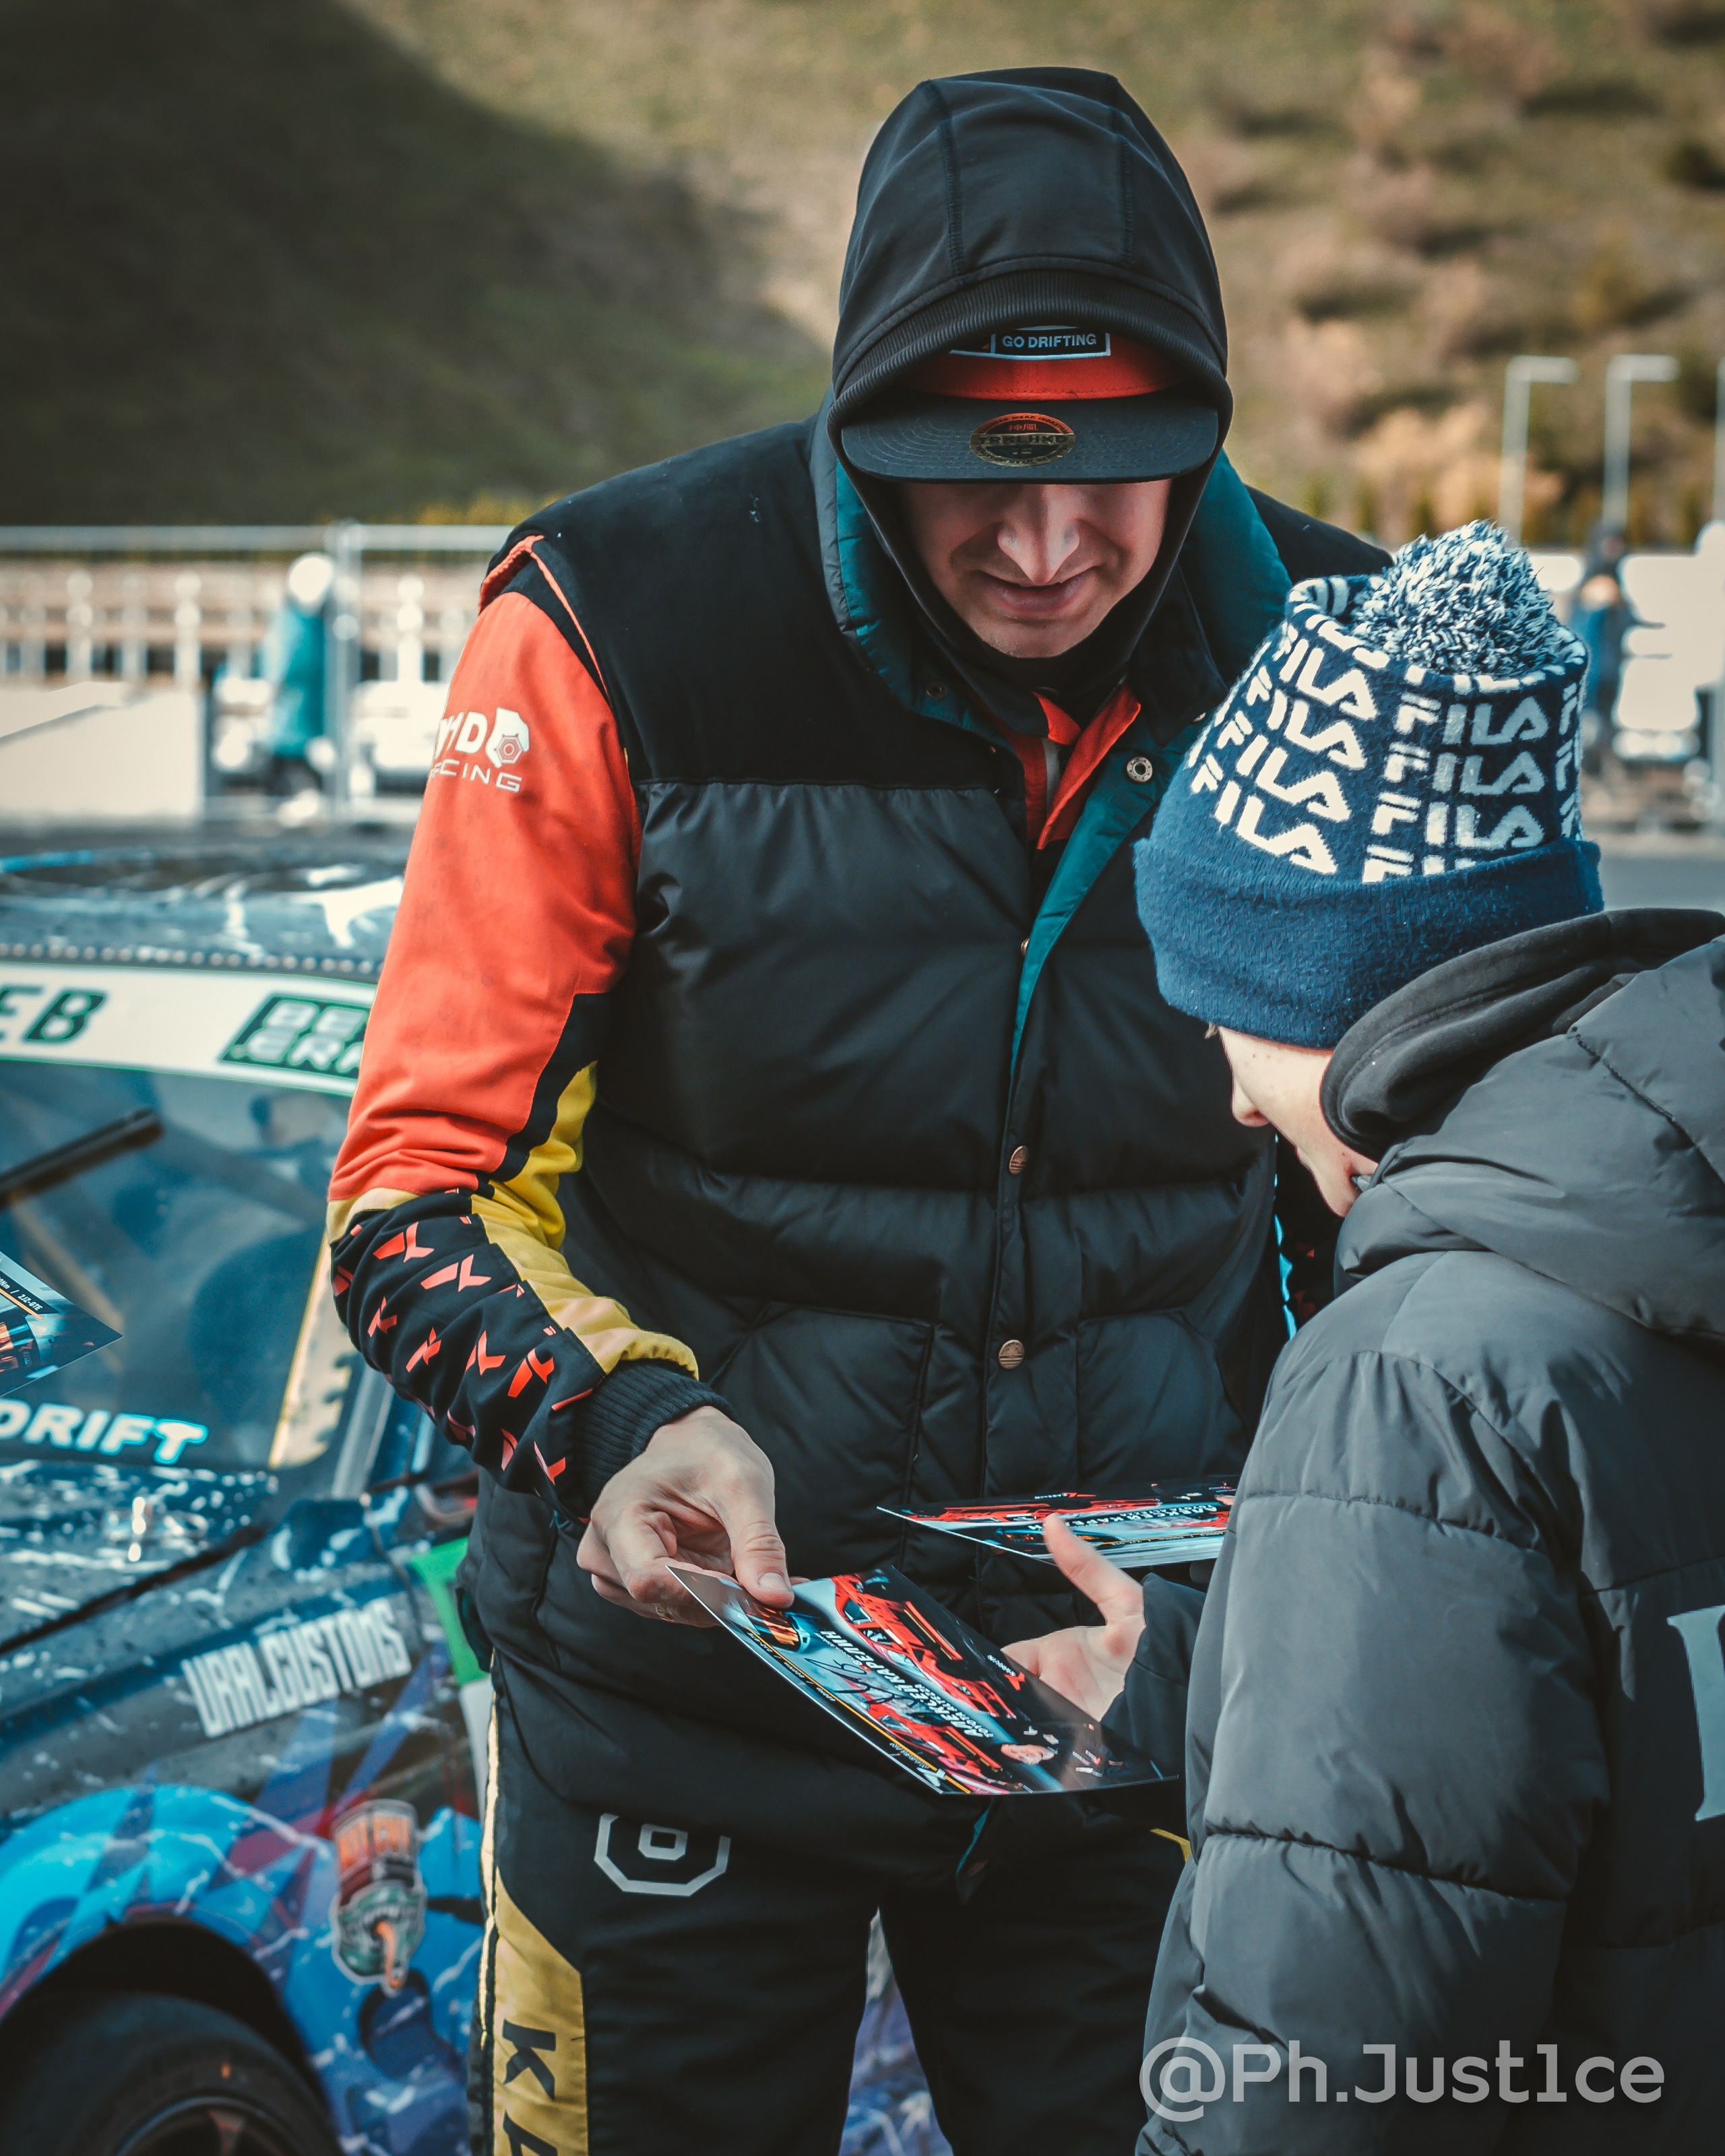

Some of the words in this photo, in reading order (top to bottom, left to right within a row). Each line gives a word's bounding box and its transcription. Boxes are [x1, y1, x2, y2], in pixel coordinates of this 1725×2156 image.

[1002, 336, 1026, 348] GO
[1028, 333, 1096, 348] DRIFTING
[1246, 665, 1368, 769] FILA
[1391, 691, 1548, 745] FILA
[1217, 711, 1352, 823] FILA
[1383, 741, 1547, 796] FILA
[1191, 754, 1339, 875] FILA
[1371, 791, 1546, 851] FILA
[0, 1398, 208, 1464] DRIFT
[819, 1630, 906, 1684] КАРЕЛИН
